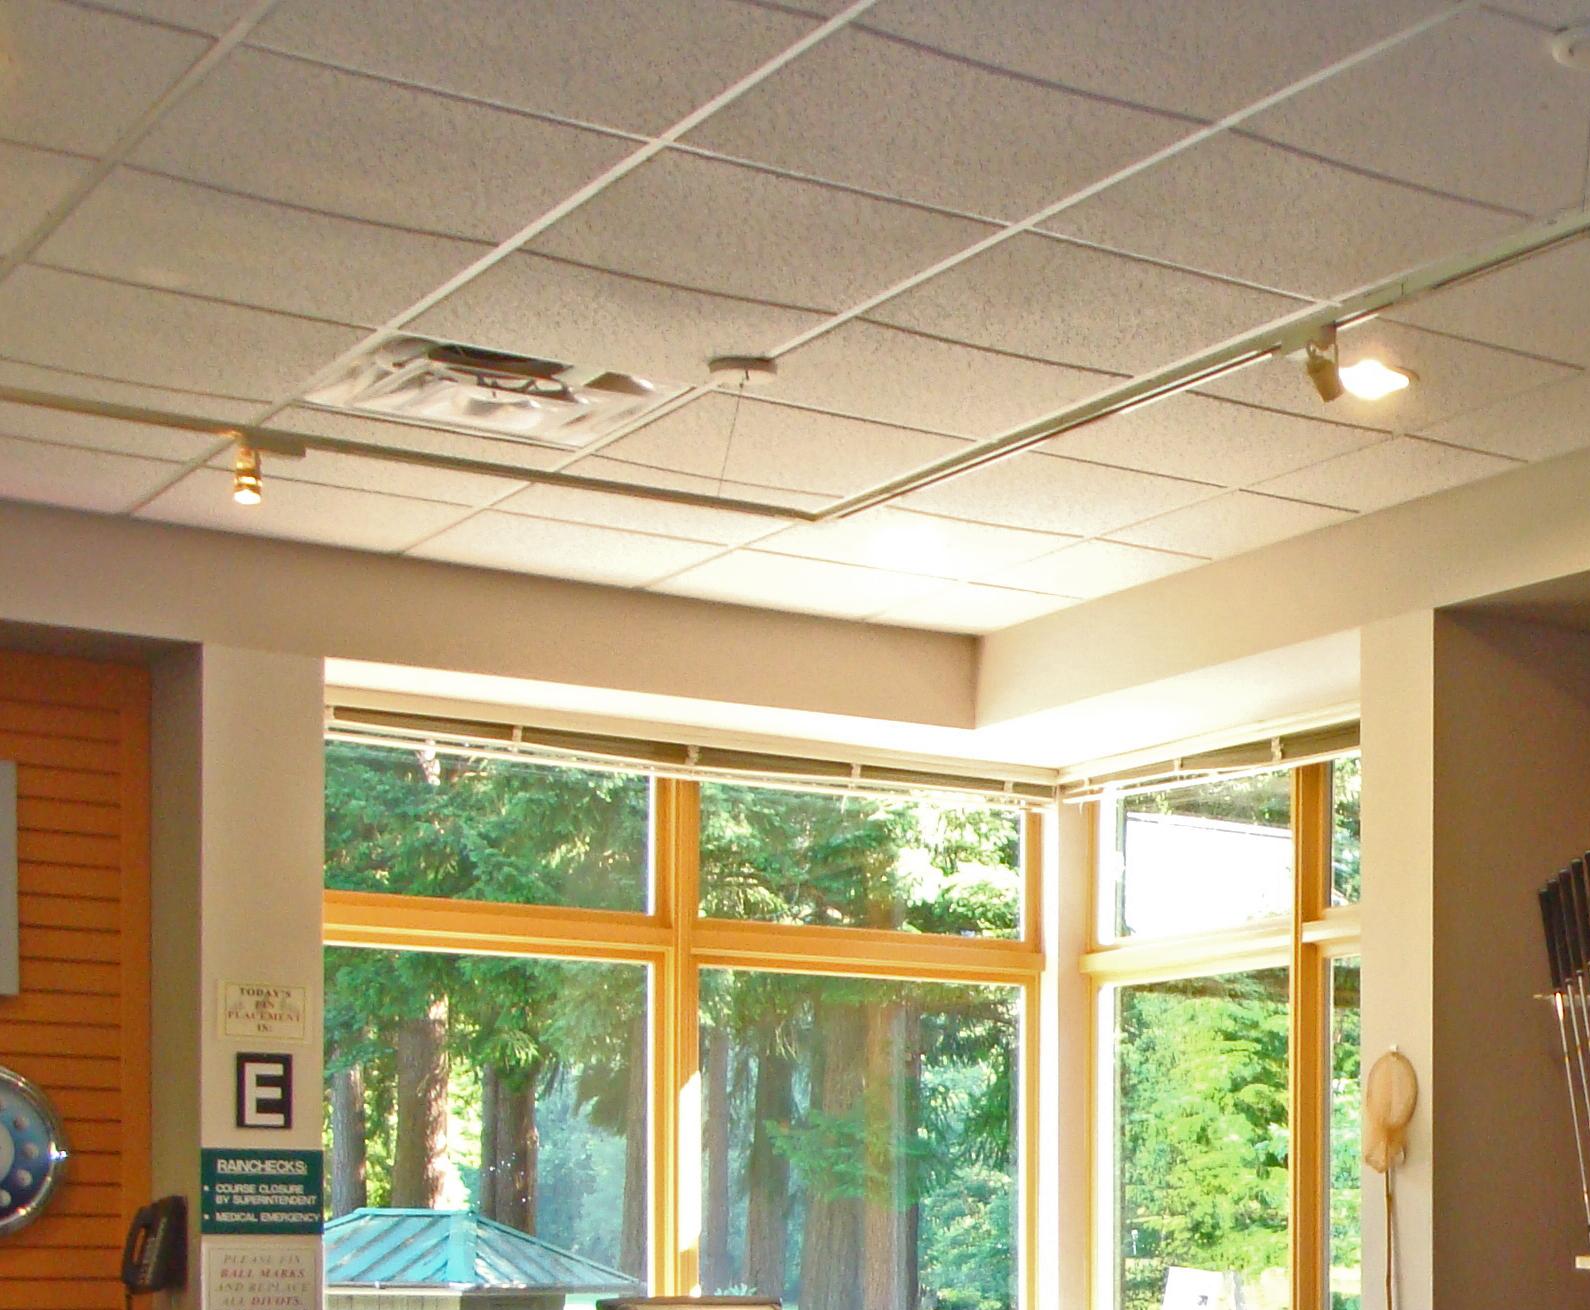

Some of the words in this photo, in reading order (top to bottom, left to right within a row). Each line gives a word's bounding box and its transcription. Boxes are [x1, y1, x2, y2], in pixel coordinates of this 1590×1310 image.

[243, 1062, 285, 1127] E
[216, 1158, 308, 1174] RAINCHECKS:
[215, 1183, 256, 1194] COURSE
[258, 1183, 304, 1194] CLOSURE
[215, 1195, 229, 1205] BY
[232, 1195, 317, 1206] SUPERINTENDENT
[215, 1212, 258, 1222] MEDICAL
[260, 1212, 319, 1223] EMERGENCY
